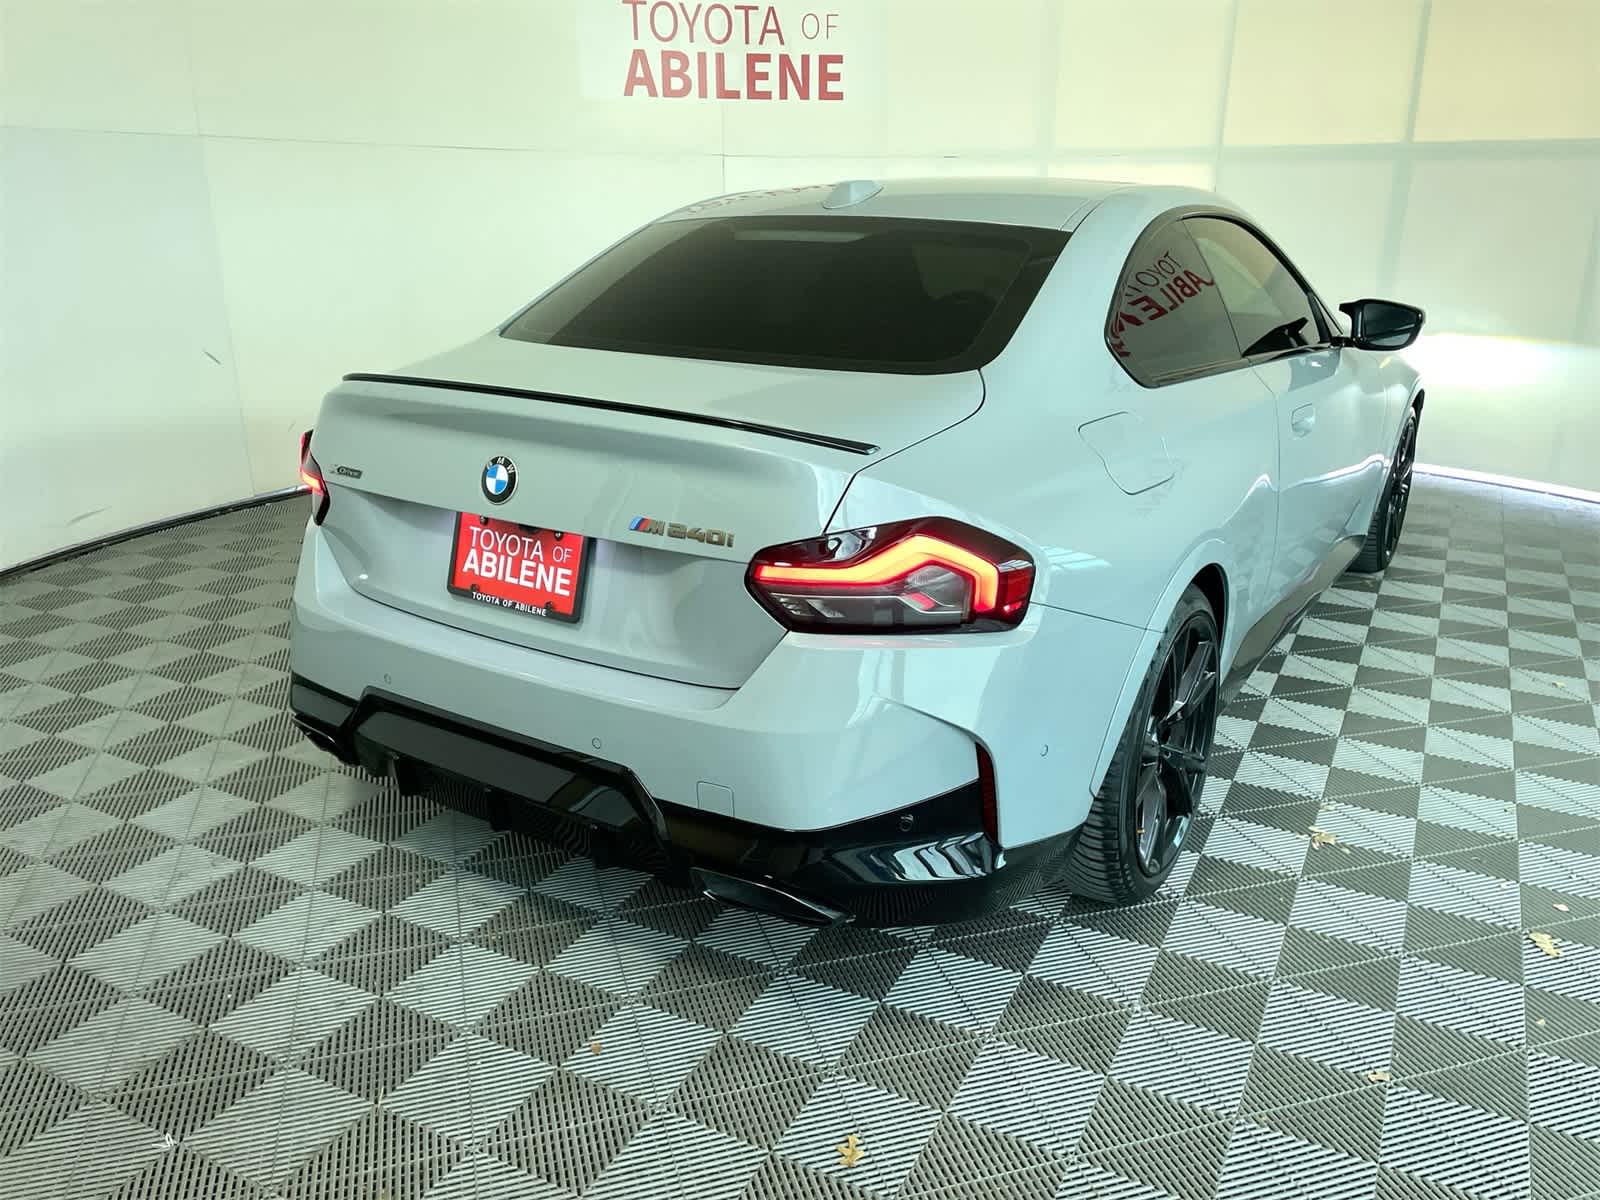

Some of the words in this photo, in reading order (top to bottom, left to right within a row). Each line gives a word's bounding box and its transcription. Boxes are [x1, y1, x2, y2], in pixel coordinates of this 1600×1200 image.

[622, 0, 785, 45] TOYOTA
[801, 13, 839, 40] OF
[623, 48, 844, 101] ABILENE
[469, 525, 544, 562] TOYOTA
[552, 545, 574, 564] OF
[462, 548, 573, 597] ABILENE
[471, 591, 500, 606] TOYOTA
[502, 599, 513, 608] OF
[515, 602, 548, 617] ABILENE
